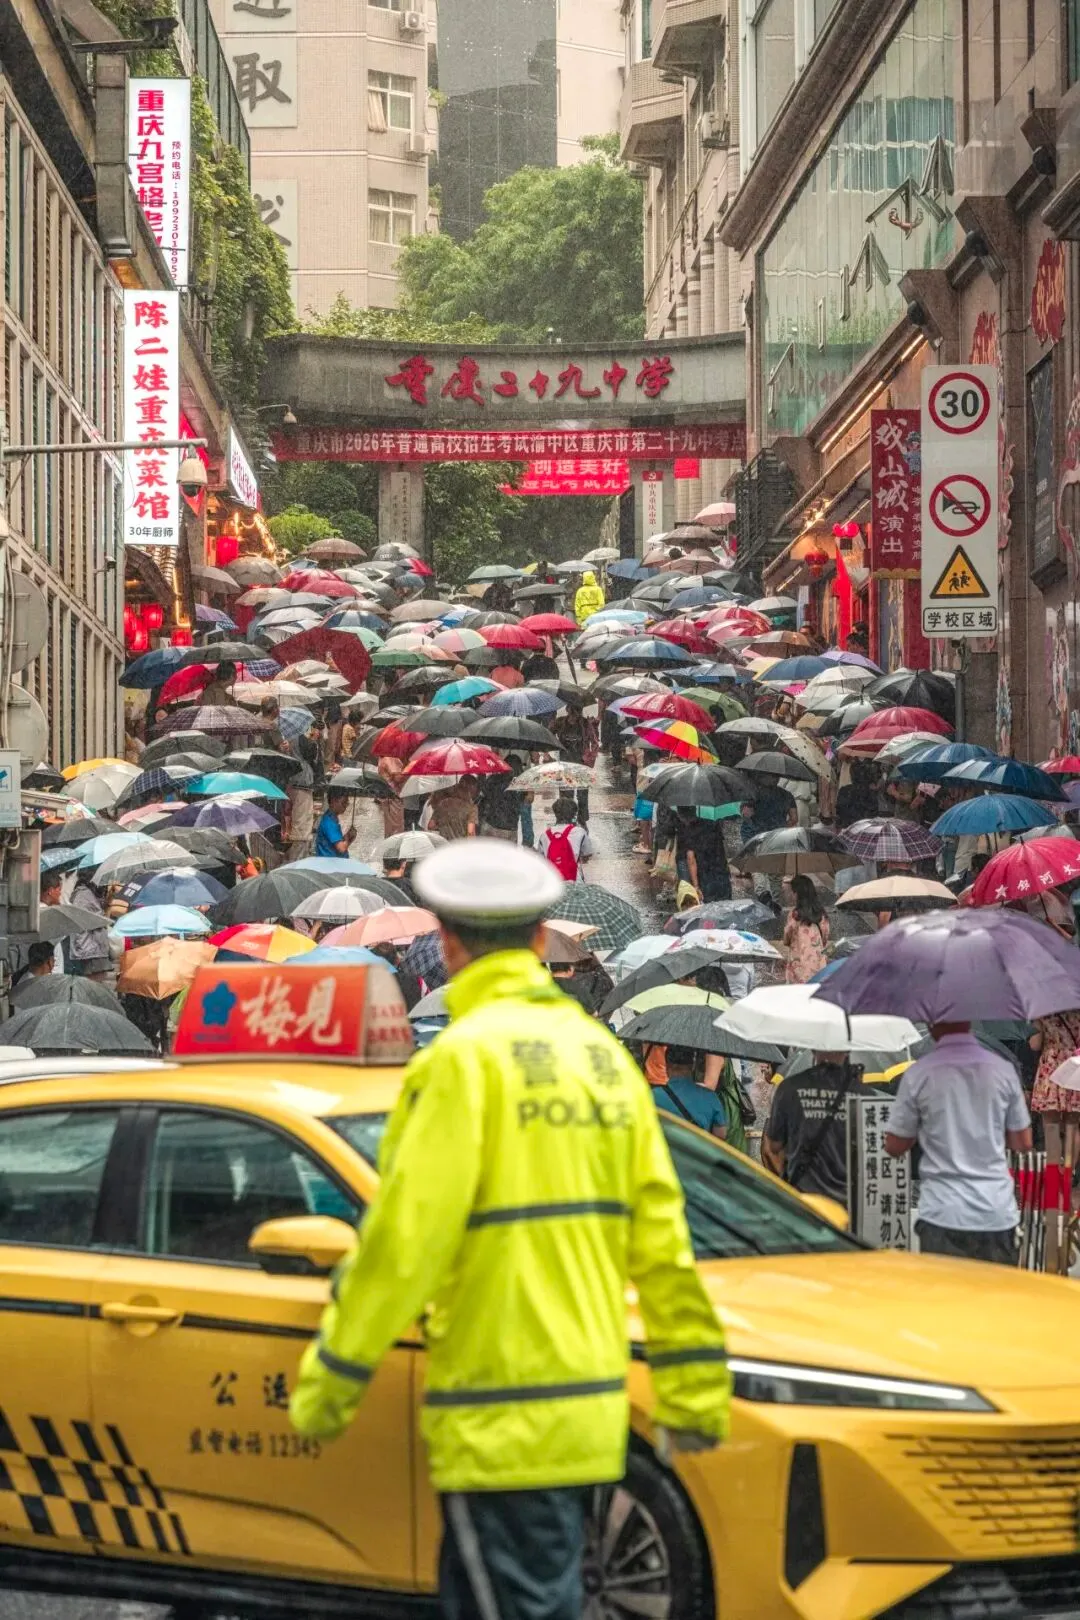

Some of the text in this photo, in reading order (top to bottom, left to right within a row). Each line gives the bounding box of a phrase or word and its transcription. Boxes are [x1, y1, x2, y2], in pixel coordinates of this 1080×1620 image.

[384, 354, 674, 407] 重庆二十九中学
[133, 301, 170, 520] 陈二娃重庆菜馆
[940, 389, 980, 419] 30
[129, 526, 174, 538] 30年厨师
[927, 611, 993, 629] 学校区域
[240, 976, 342, 1047] 梅见
[511, 1039, 623, 1089] 警察
[797, 1088, 818, 1097] THE
[800, 1099, 827, 1108] THAT
[517, 1096, 633, 1131] POLICE
[864, 1105, 879, 1207] 减速慢行
